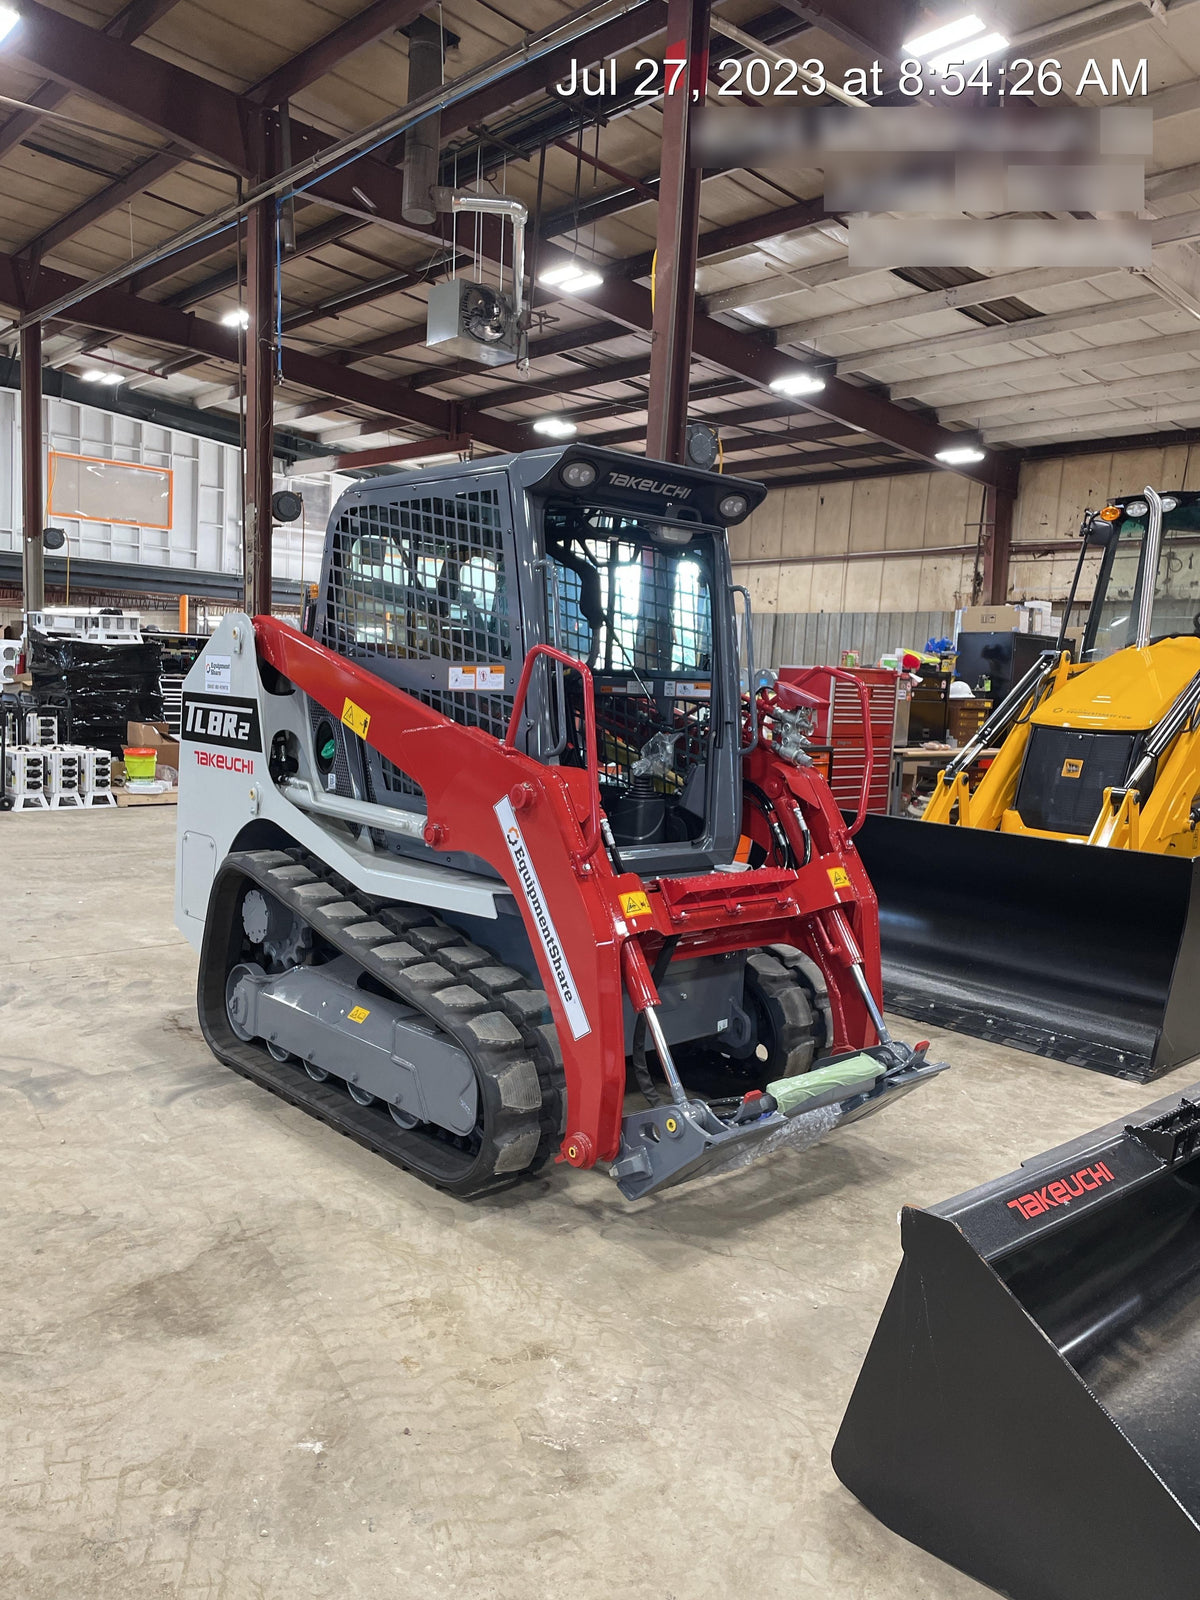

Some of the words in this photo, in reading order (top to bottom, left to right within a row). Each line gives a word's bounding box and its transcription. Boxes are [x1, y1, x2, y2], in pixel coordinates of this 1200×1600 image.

[608, 471, 692, 500] TAKEUCHI
[194, 750, 255, 775] TAKEUCHI
[513, 846, 574, 1003] EquipmentShare
[1006, 1161, 1116, 1220] TAKEUCHI
